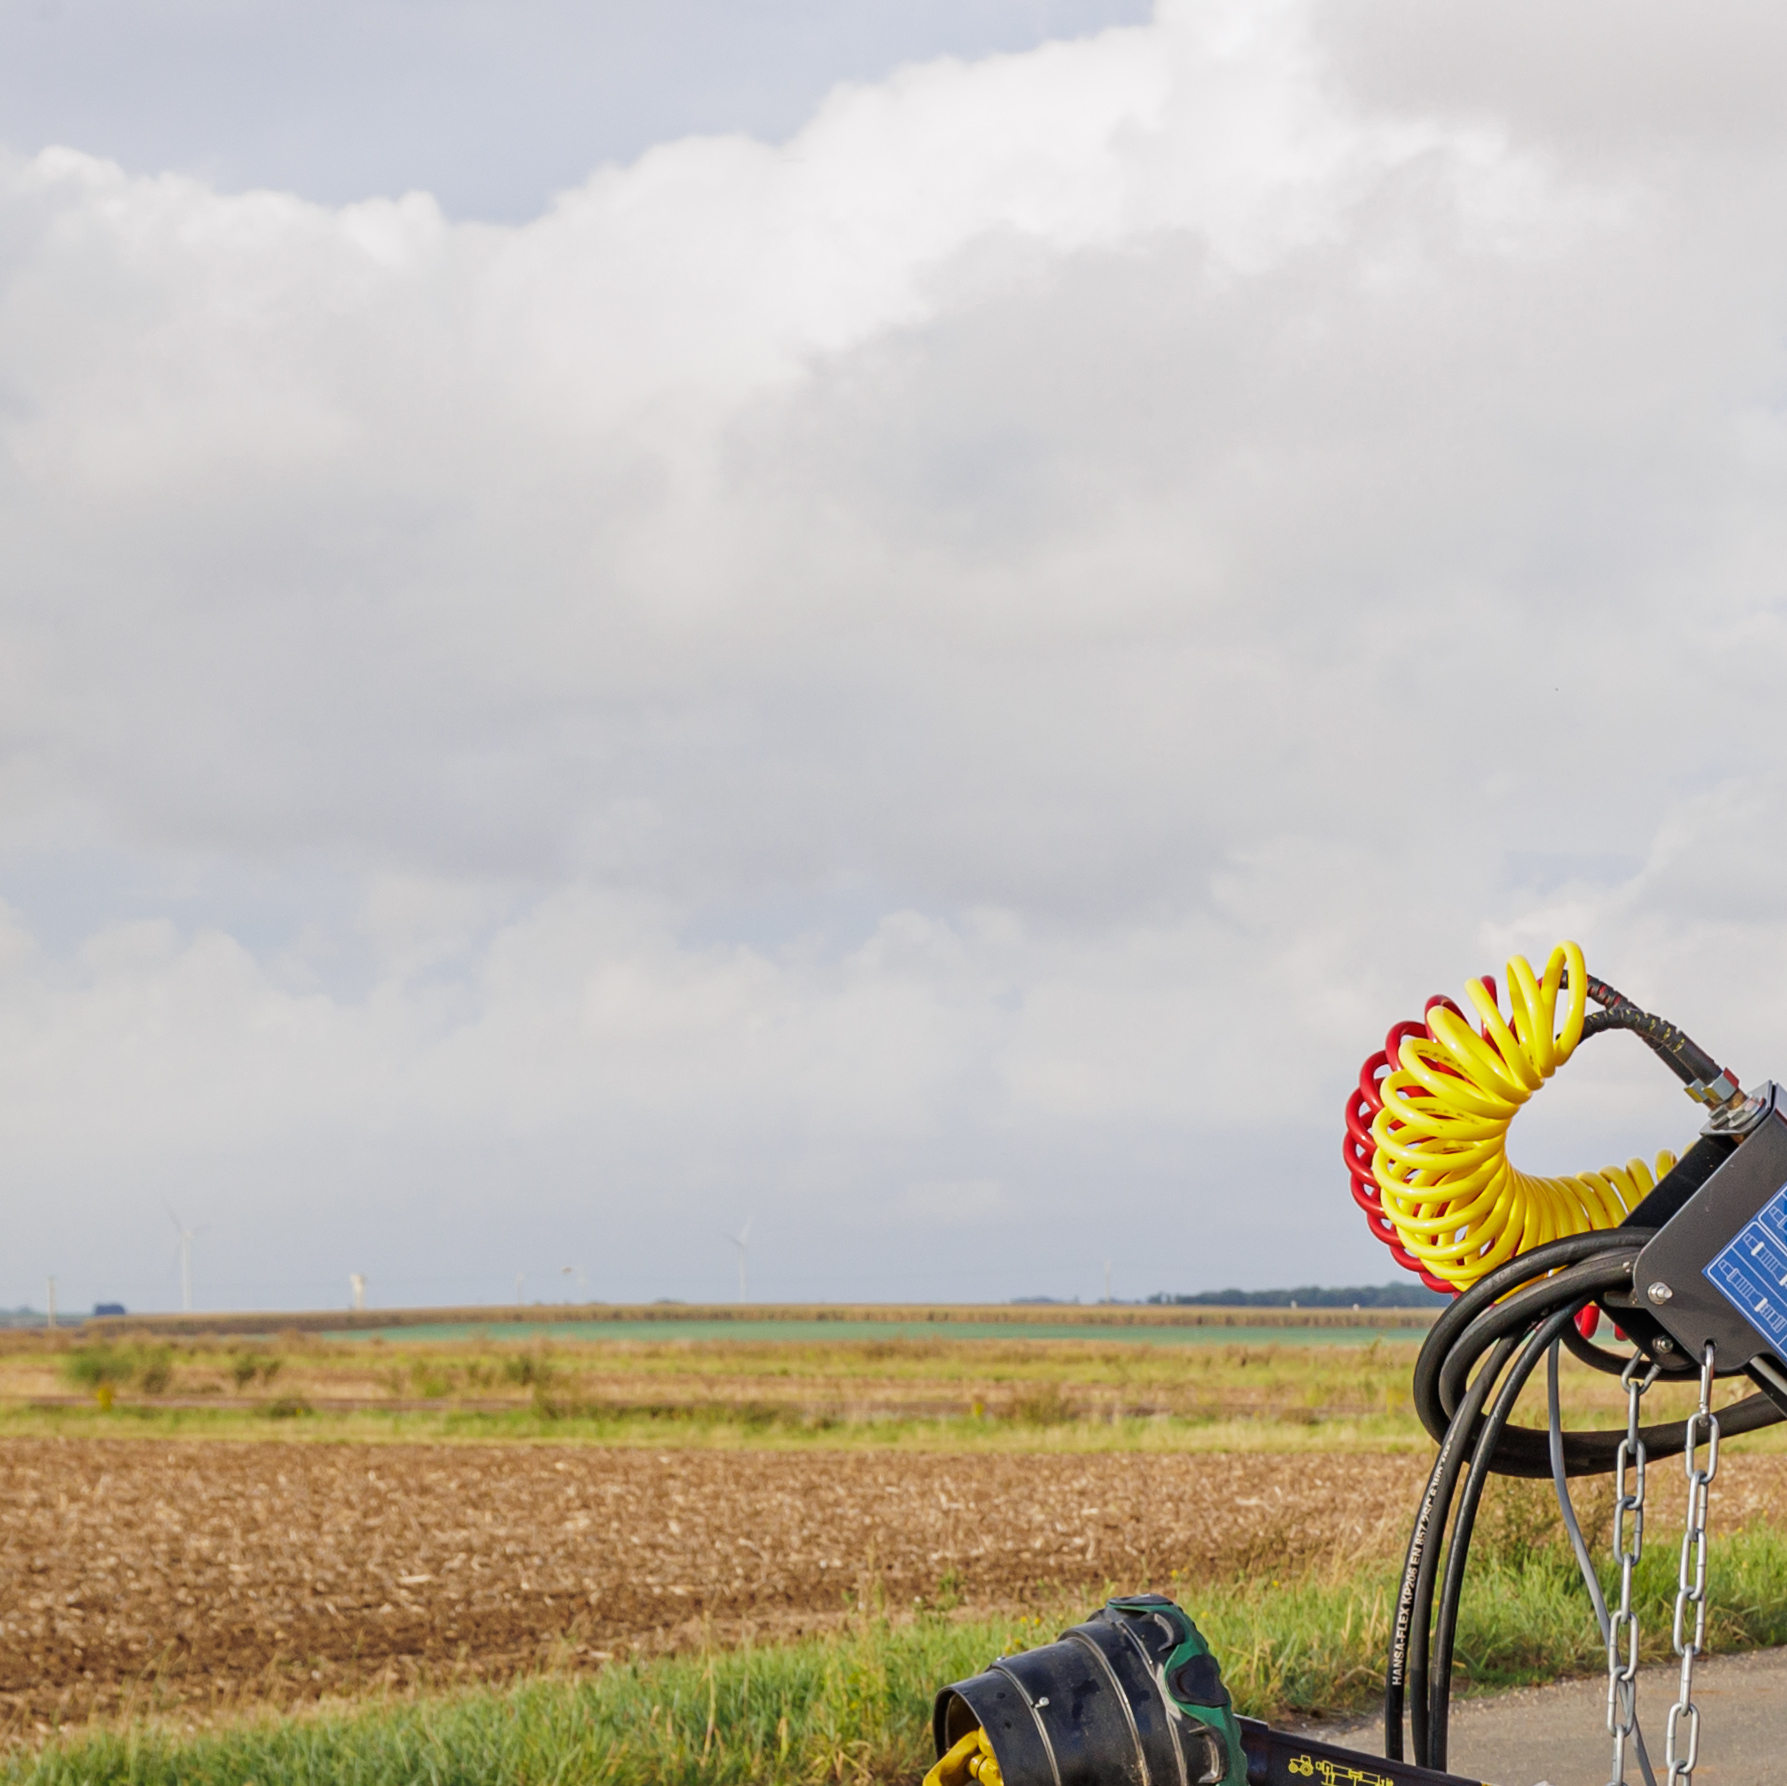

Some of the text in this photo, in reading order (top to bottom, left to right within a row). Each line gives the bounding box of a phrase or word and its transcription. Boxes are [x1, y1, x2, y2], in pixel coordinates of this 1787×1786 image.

[1392, 1606, 1410, 1685] HANSA-FLEX
[1401, 1567, 1418, 1605] KP206
[1411, 1547, 1423, 1565] EN
